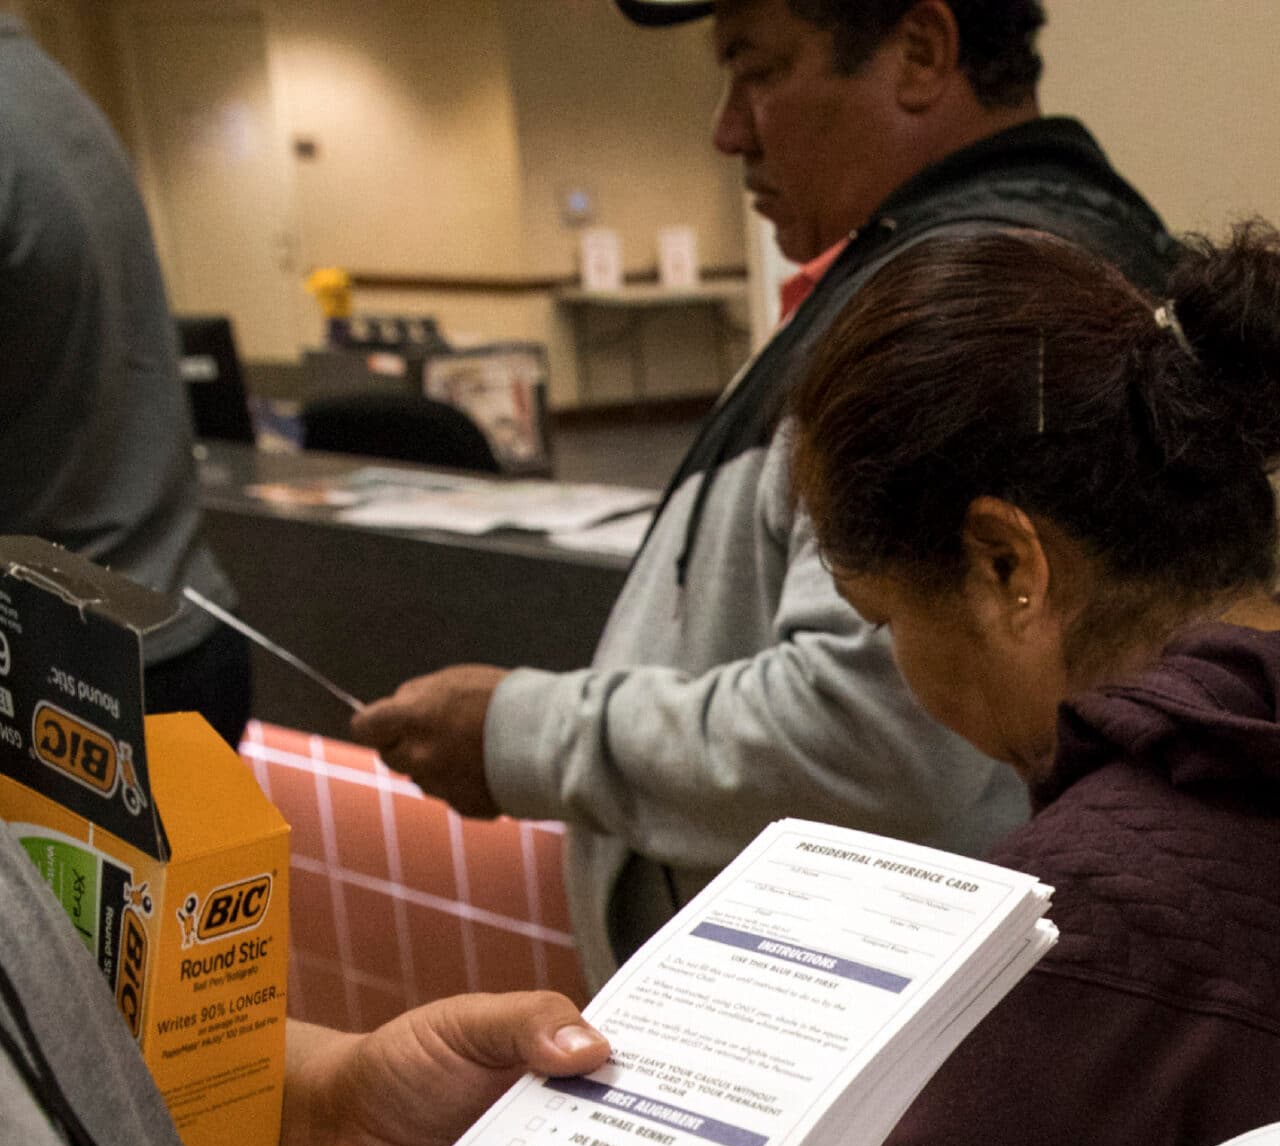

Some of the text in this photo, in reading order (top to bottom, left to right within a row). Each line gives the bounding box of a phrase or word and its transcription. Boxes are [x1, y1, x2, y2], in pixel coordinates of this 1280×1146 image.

[51, 667, 120, 720] Round Stic
[42, 720, 109, 783] BIC
[797, 841, 980, 893] PRESIDENTIAL PREFERENCE CARD
[204, 884, 267, 930] BIC
[103, 906, 114, 958] Round
[180, 938, 268, 982] Round Stic
[730, 955, 839, 989] USE THIS BLUE SIDE FIRST
[758, 940, 837, 969] INSTRUCTIONS
[157, 1013, 197, 1036] Writes
[201, 1001, 226, 1023] 90%
[618, 1051, 639, 1060] NOT
[638, 1057, 666, 1069] LEAVE
[668, 1064, 693, 1078] YOUR
[693, 1073, 731, 1090] CAUCUS
[732, 1085, 777, 1102] WITHOUT
[635, 1065, 655, 1077] THIS
[656, 1072, 682, 1084] CARD
[682, 1079, 696, 1089] TO
[698, 1084, 724, 1098] YOUR
[724, 1093, 782, 1115] PERMANENT
[658, 1084, 687, 1097] CHAIR
[590, 1111, 675, 1145] MICHAEL BENNET
[603, 1090, 703, 1130] FIRST ALIGNMENT
[569, 1133, 590, 1146] JOE
